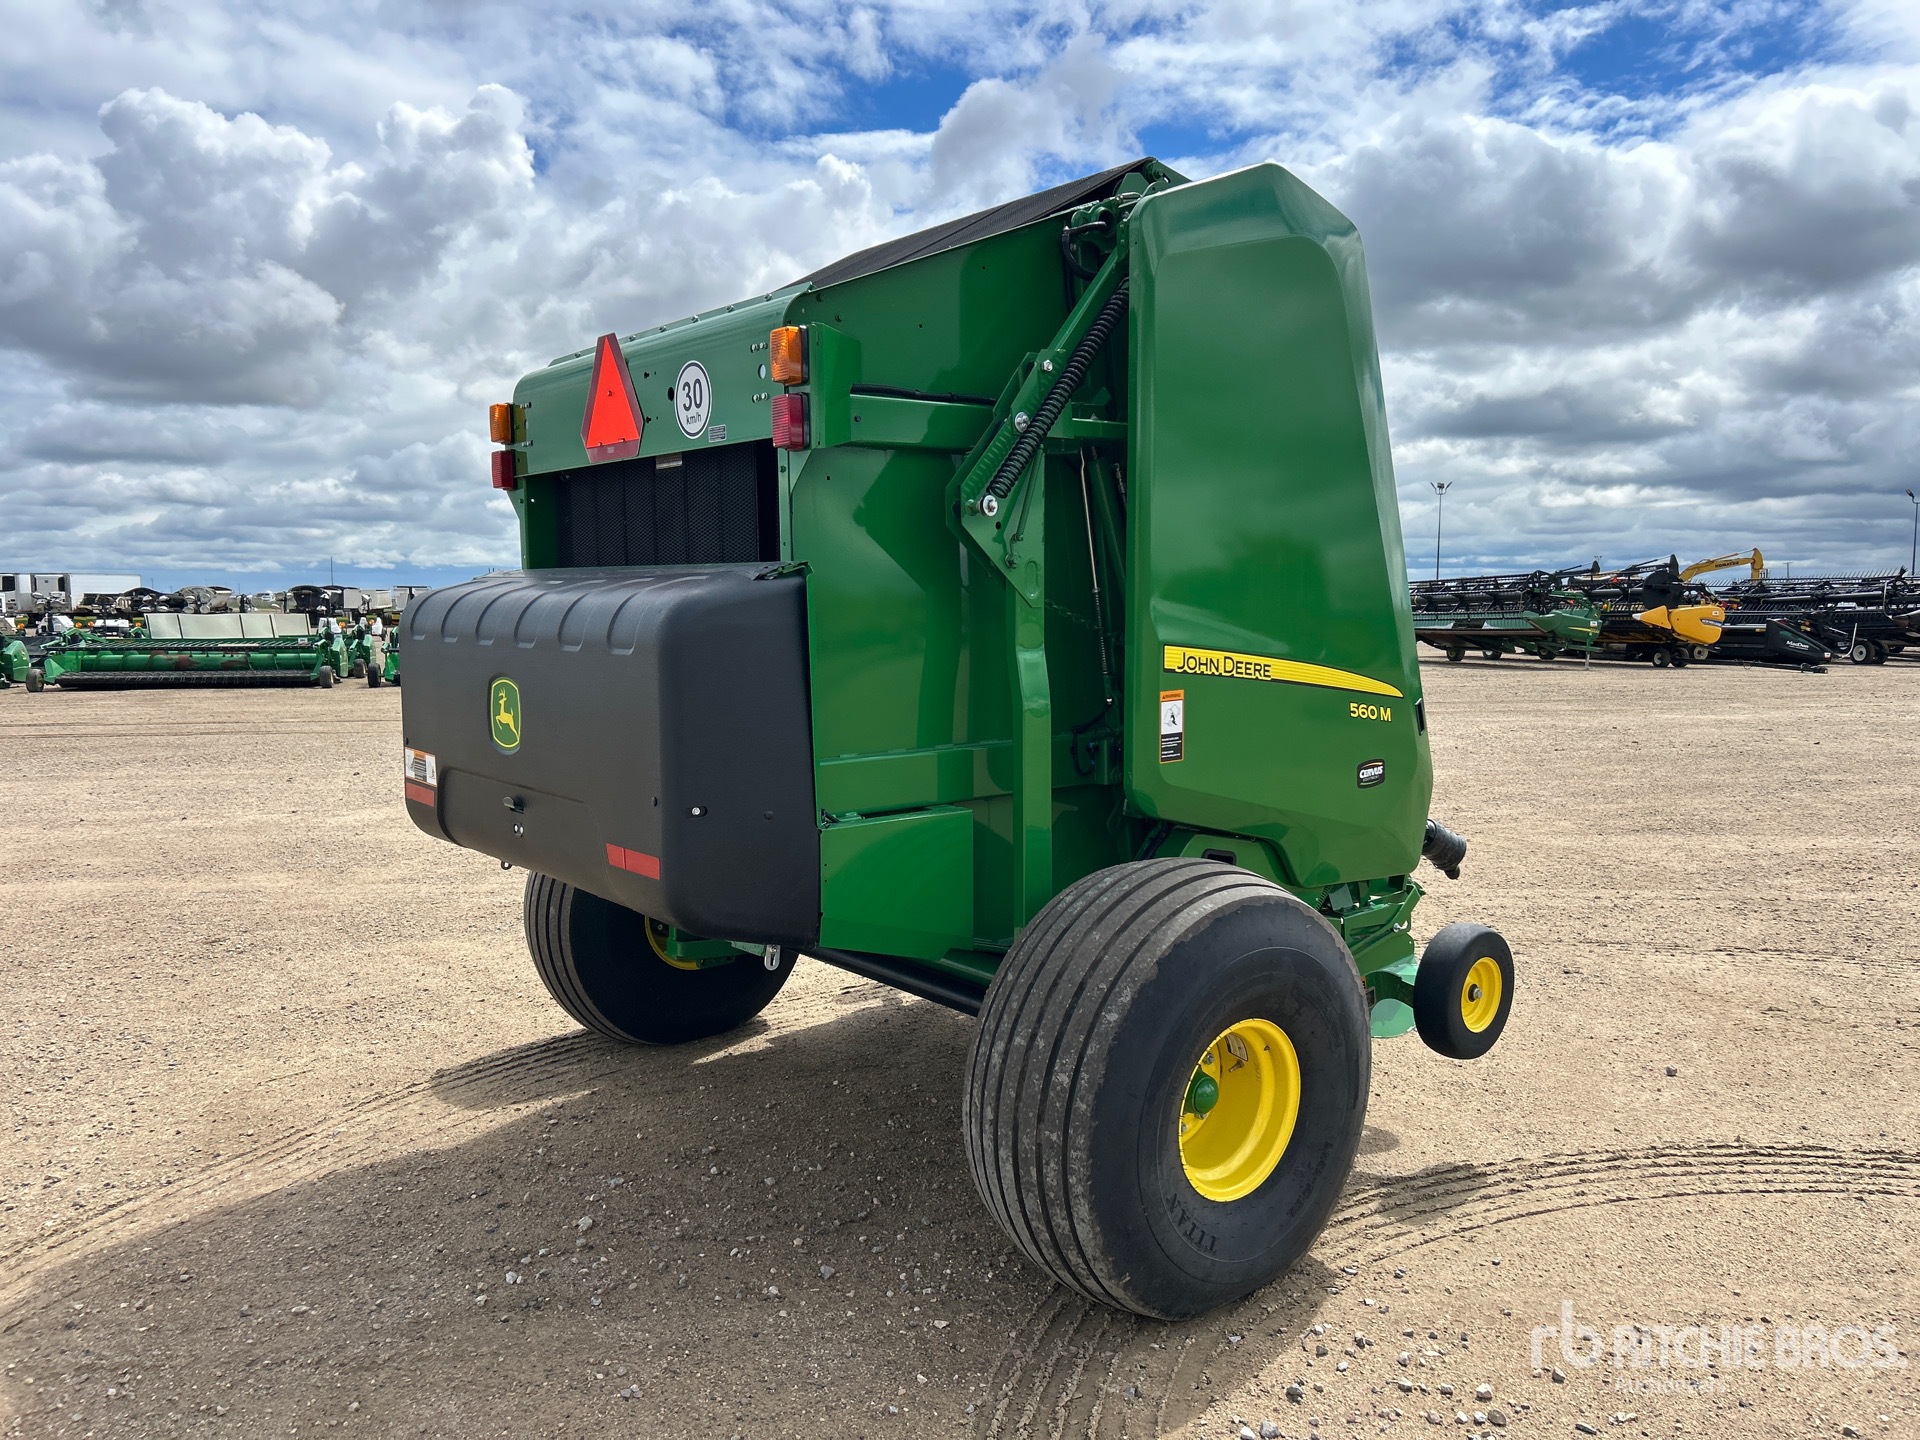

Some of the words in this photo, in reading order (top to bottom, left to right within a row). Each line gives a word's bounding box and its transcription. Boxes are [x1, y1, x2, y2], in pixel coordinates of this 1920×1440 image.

[682, 378, 703, 412] 30
[686, 412, 702, 425] km/h
[1786, 640, 1810, 649] MacDon
[1177, 652, 1220, 672] JOHN
[1223, 656, 1272, 679] DEERE
[1350, 702, 1378, 720] 560
[1380, 706, 1392, 722] M
[1359, 766, 1384, 779] CERVUS
[1165, 1193, 1217, 1255] TITAN
